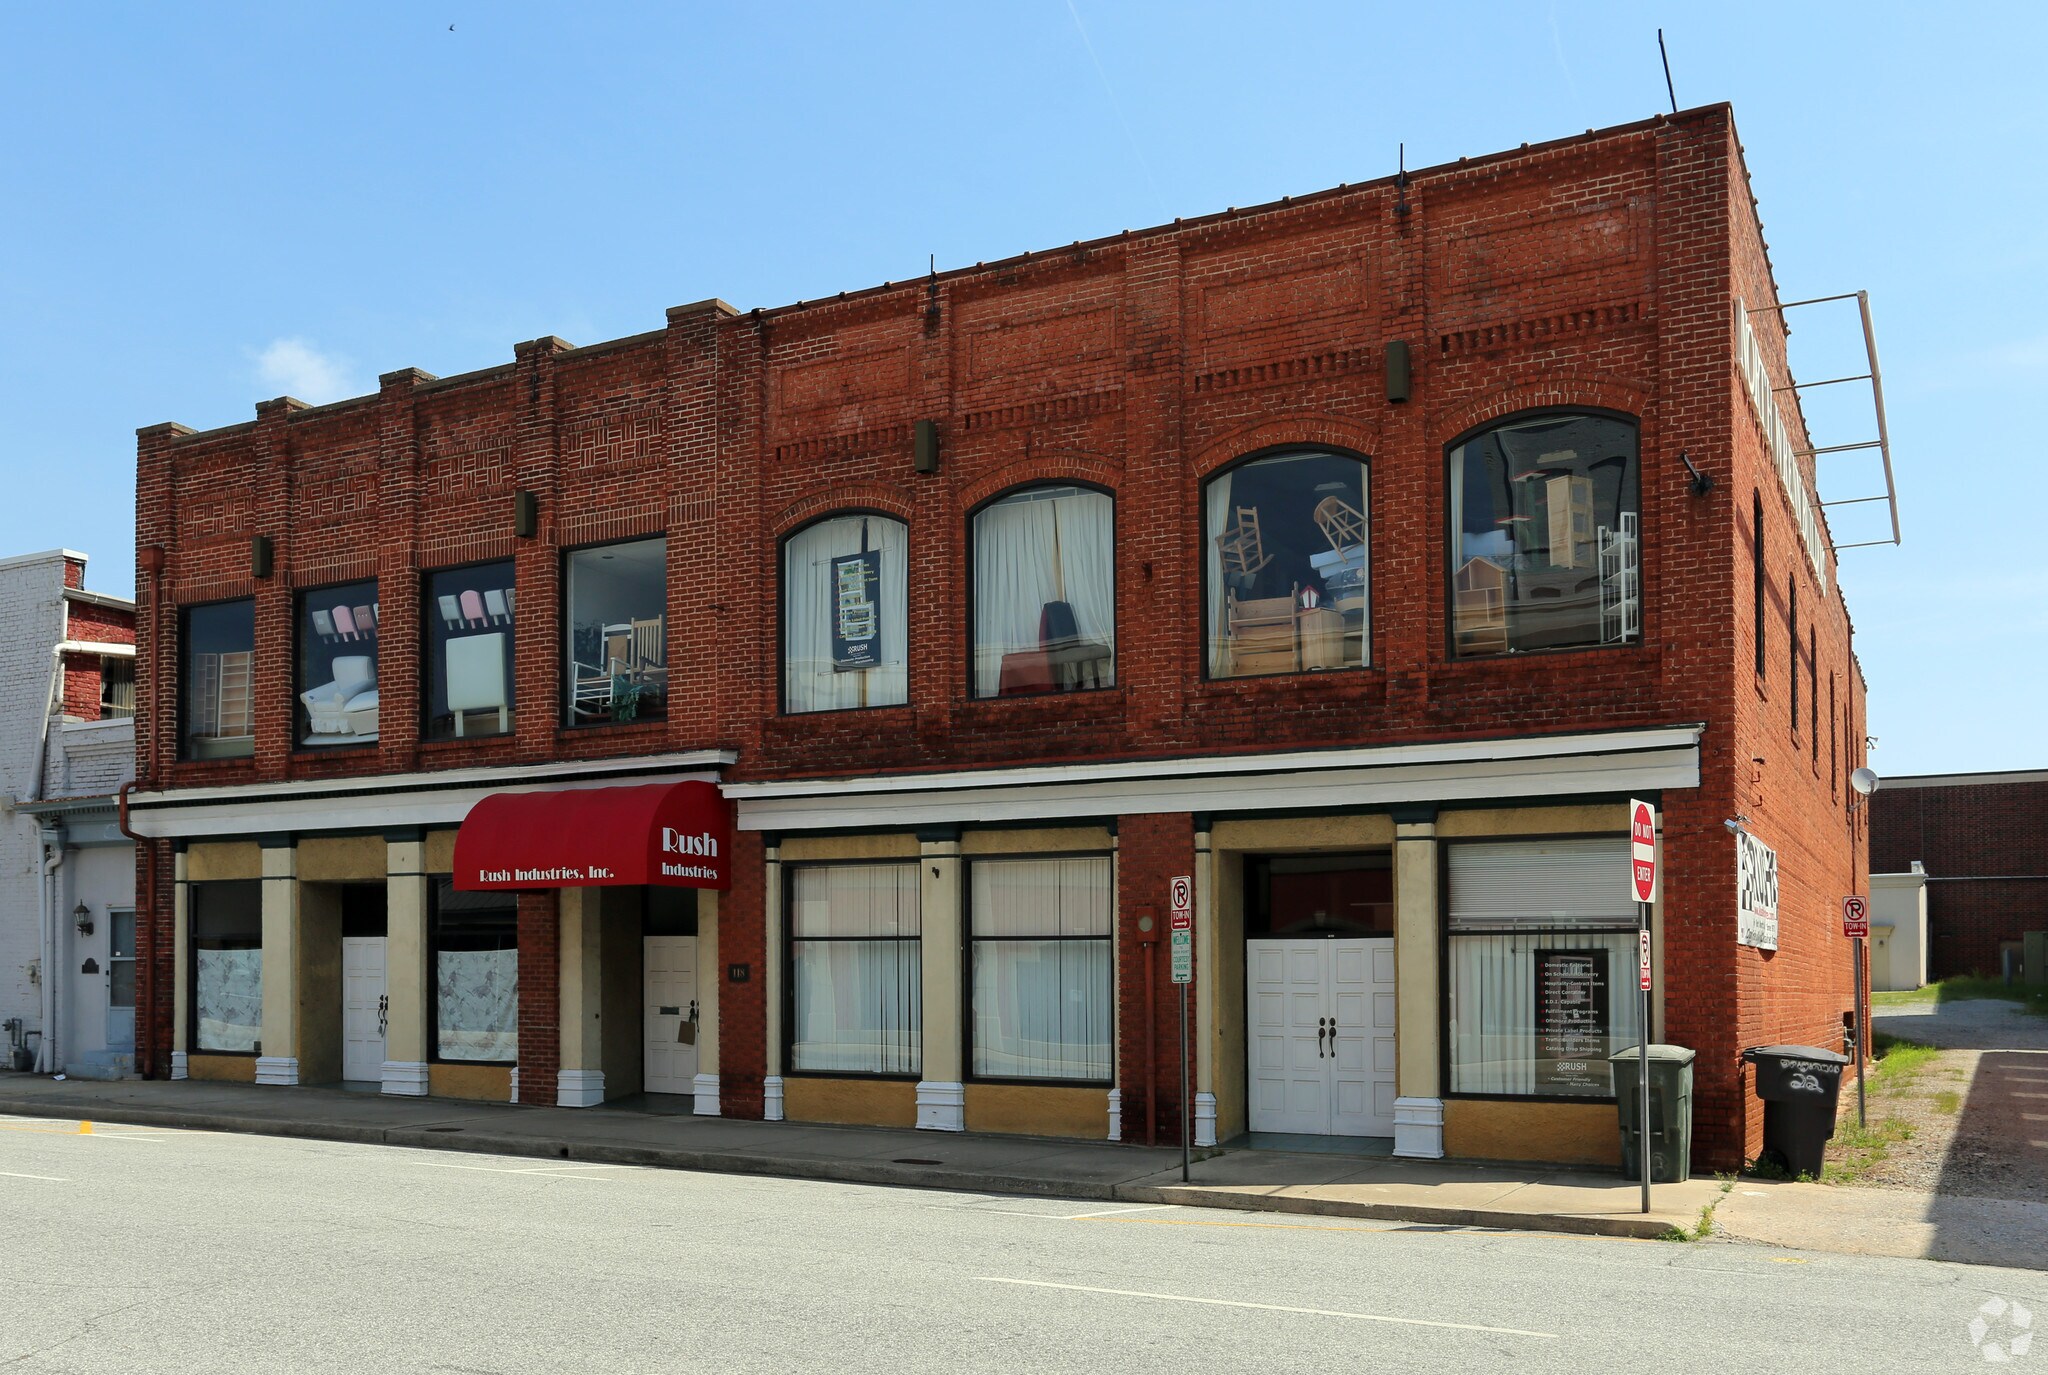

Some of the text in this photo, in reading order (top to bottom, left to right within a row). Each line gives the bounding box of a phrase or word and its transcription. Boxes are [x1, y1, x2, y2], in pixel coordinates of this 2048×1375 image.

[1735, 296, 1773, 450] NORTH
[853, 643, 868, 652] RUSH
[1635, 822, 1652, 839] DO NOT
[663, 827, 717, 857] Rush
[480, 870, 511, 882] Rush
[589, 866, 614, 879] Inc.
[662, 862, 718, 880] Industries
[1637, 866, 1651, 881] ENTER
[1173, 911, 1189, 920] TOW-IN
[1173, 935, 1189, 945] WELCOME
[1565, 1062, 1587, 1070] RUSH
